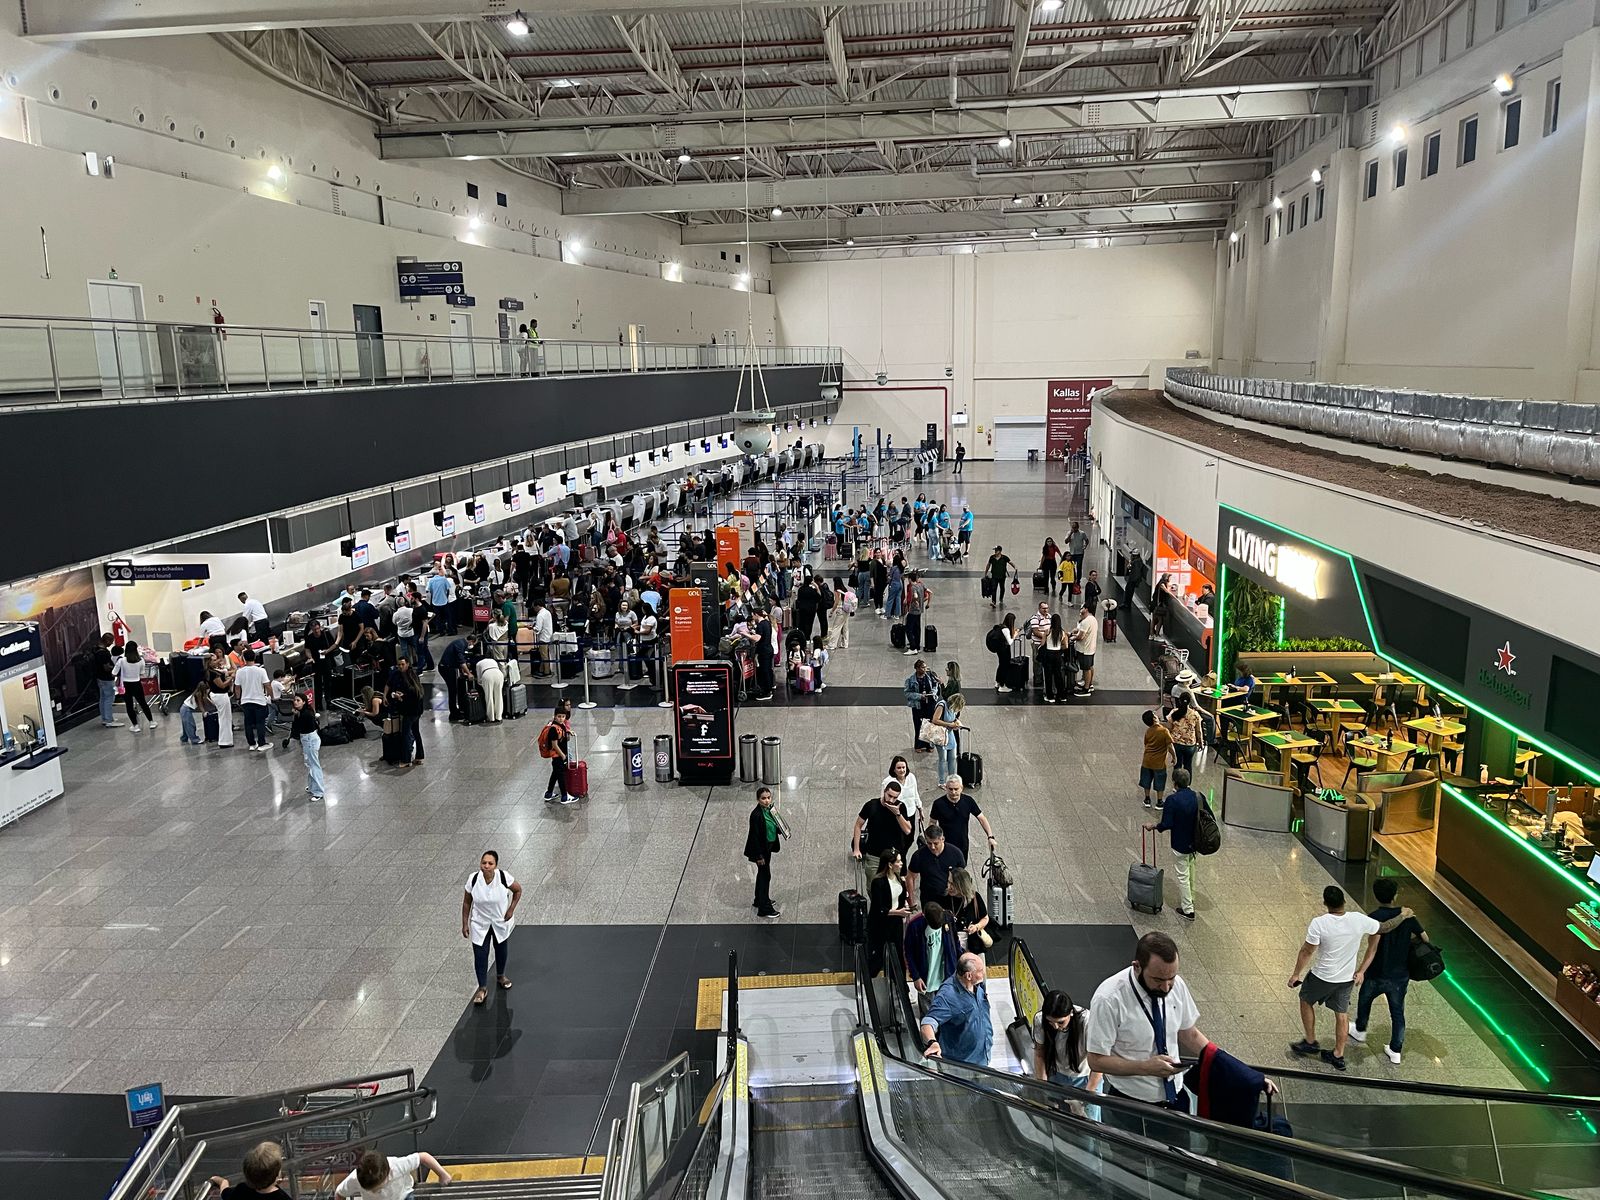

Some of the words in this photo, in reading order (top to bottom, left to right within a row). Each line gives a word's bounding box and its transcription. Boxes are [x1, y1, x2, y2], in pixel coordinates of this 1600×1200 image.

[1053, 388, 1080, 397] Kallas
[1228, 526, 1277, 578] LIVING
[1479, 668, 1533, 711] Heineken
